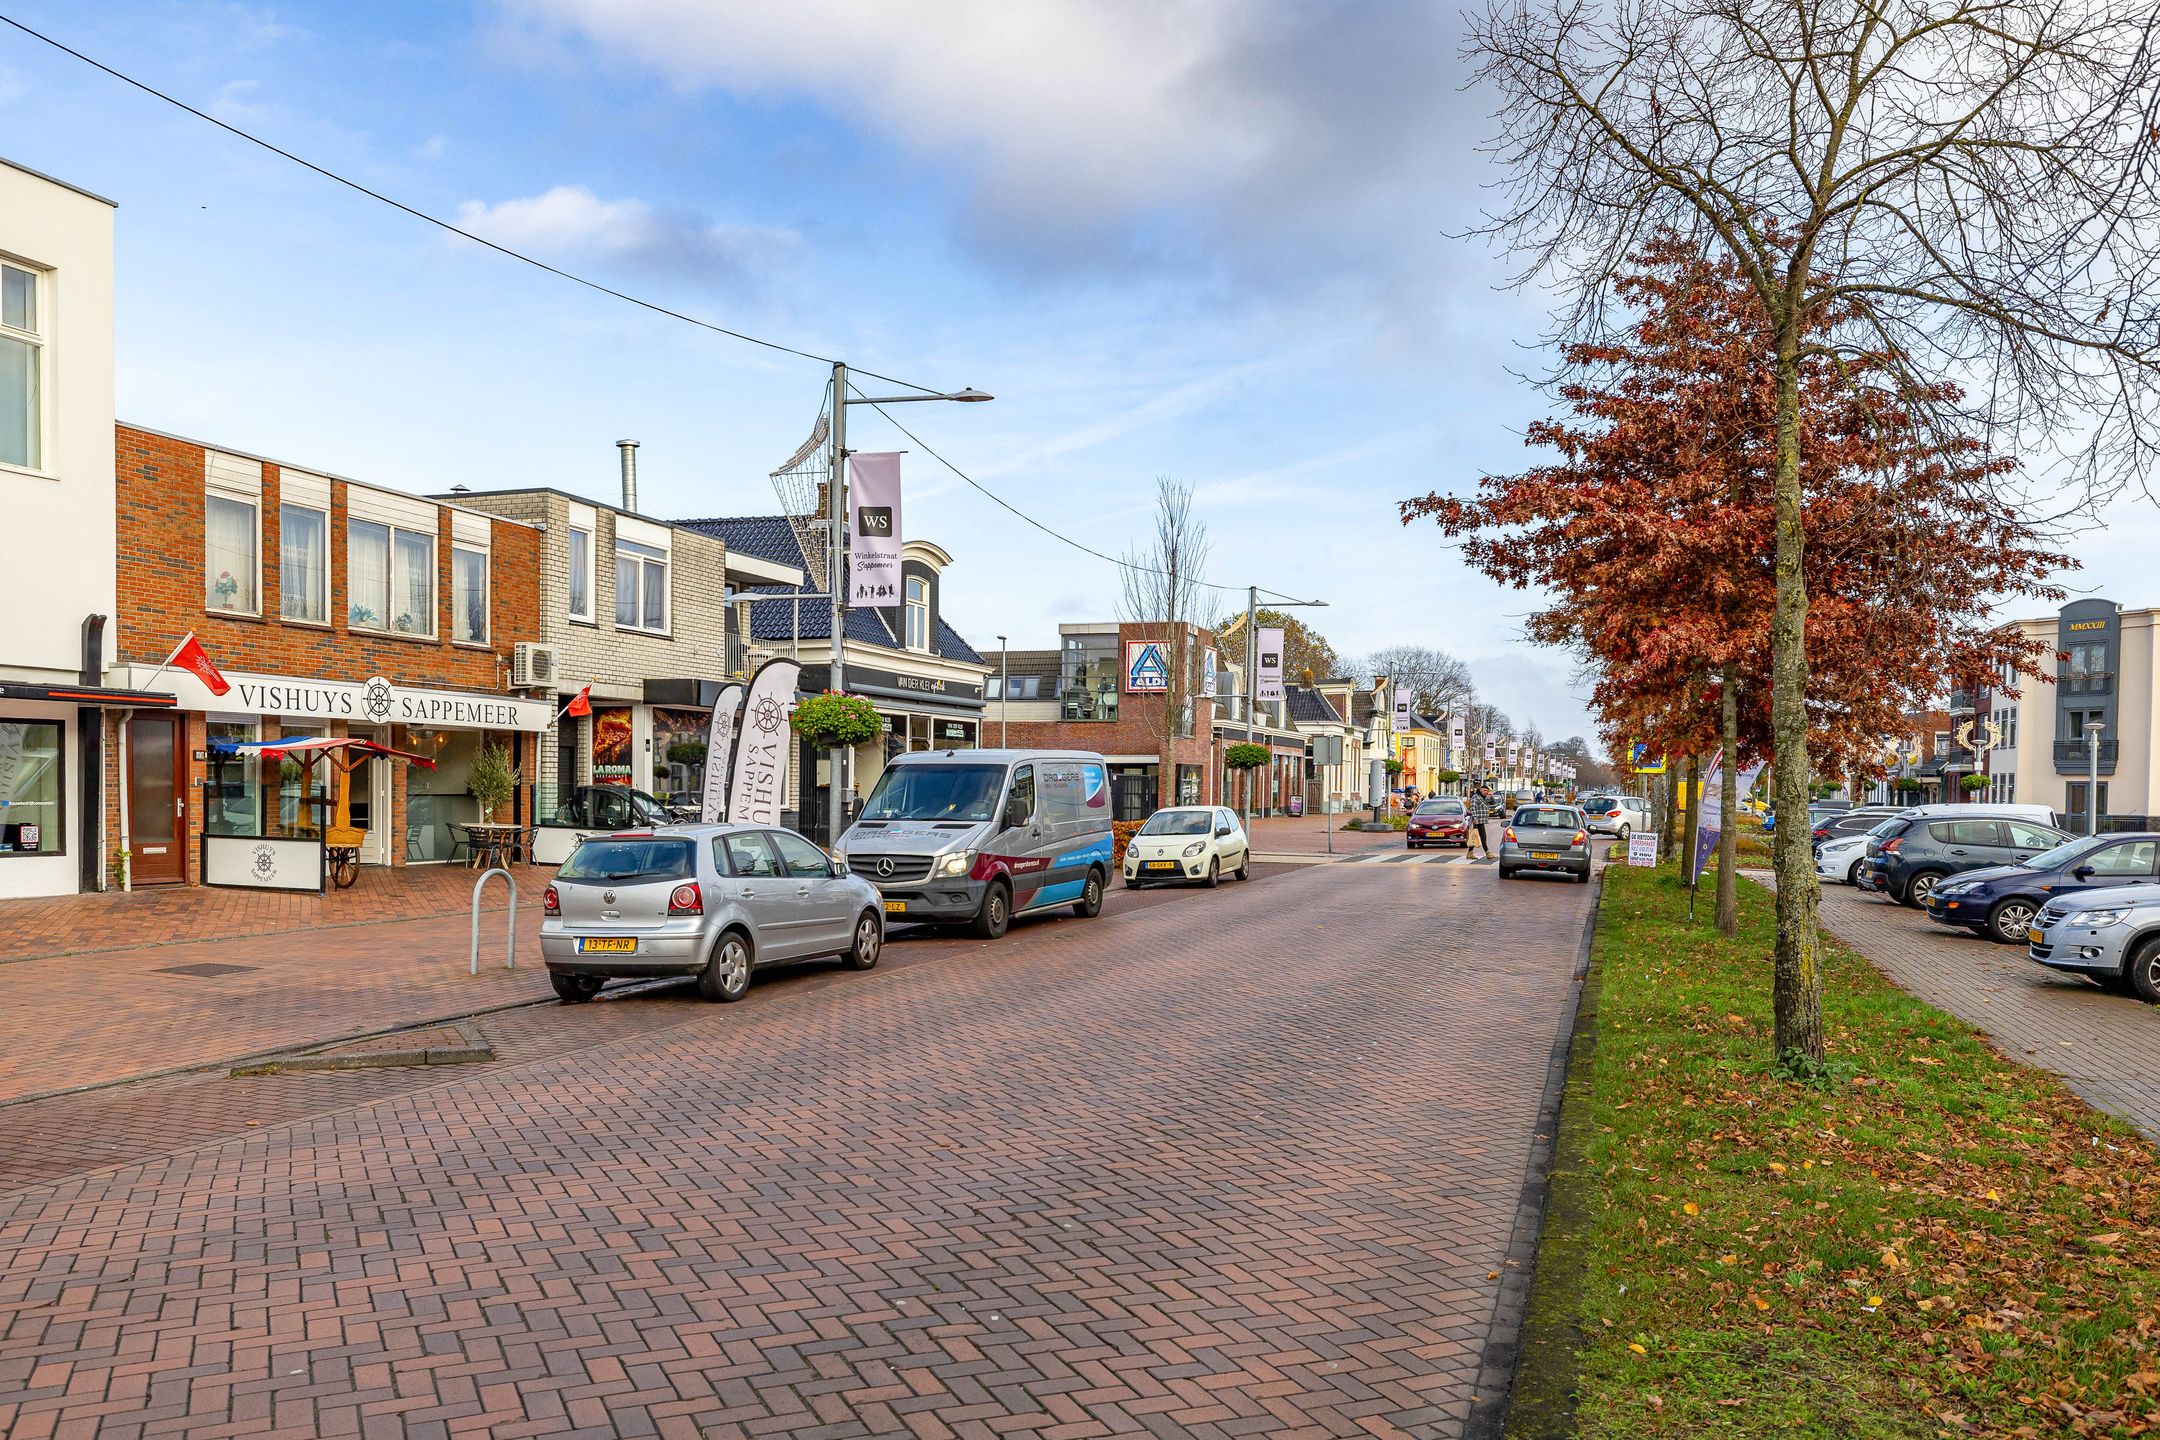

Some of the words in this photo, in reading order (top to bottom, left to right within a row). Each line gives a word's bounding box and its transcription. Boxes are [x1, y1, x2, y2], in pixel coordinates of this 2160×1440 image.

[863, 515, 888, 529] WS
[854, 551, 898, 560] Winkelstraat
[2069, 620, 2106, 631] MMXXIII
[1264, 656, 1277, 664] WS
[896, 676, 908, 688] VAN
[908, 678, 919, 690] DER
[919, 679, 930, 691] KLEI
[239, 684, 352, 714] VISHUYS
[402, 697, 519, 726] SAPPEMEER
[588, 940, 630, 950] 13-TF-NR
